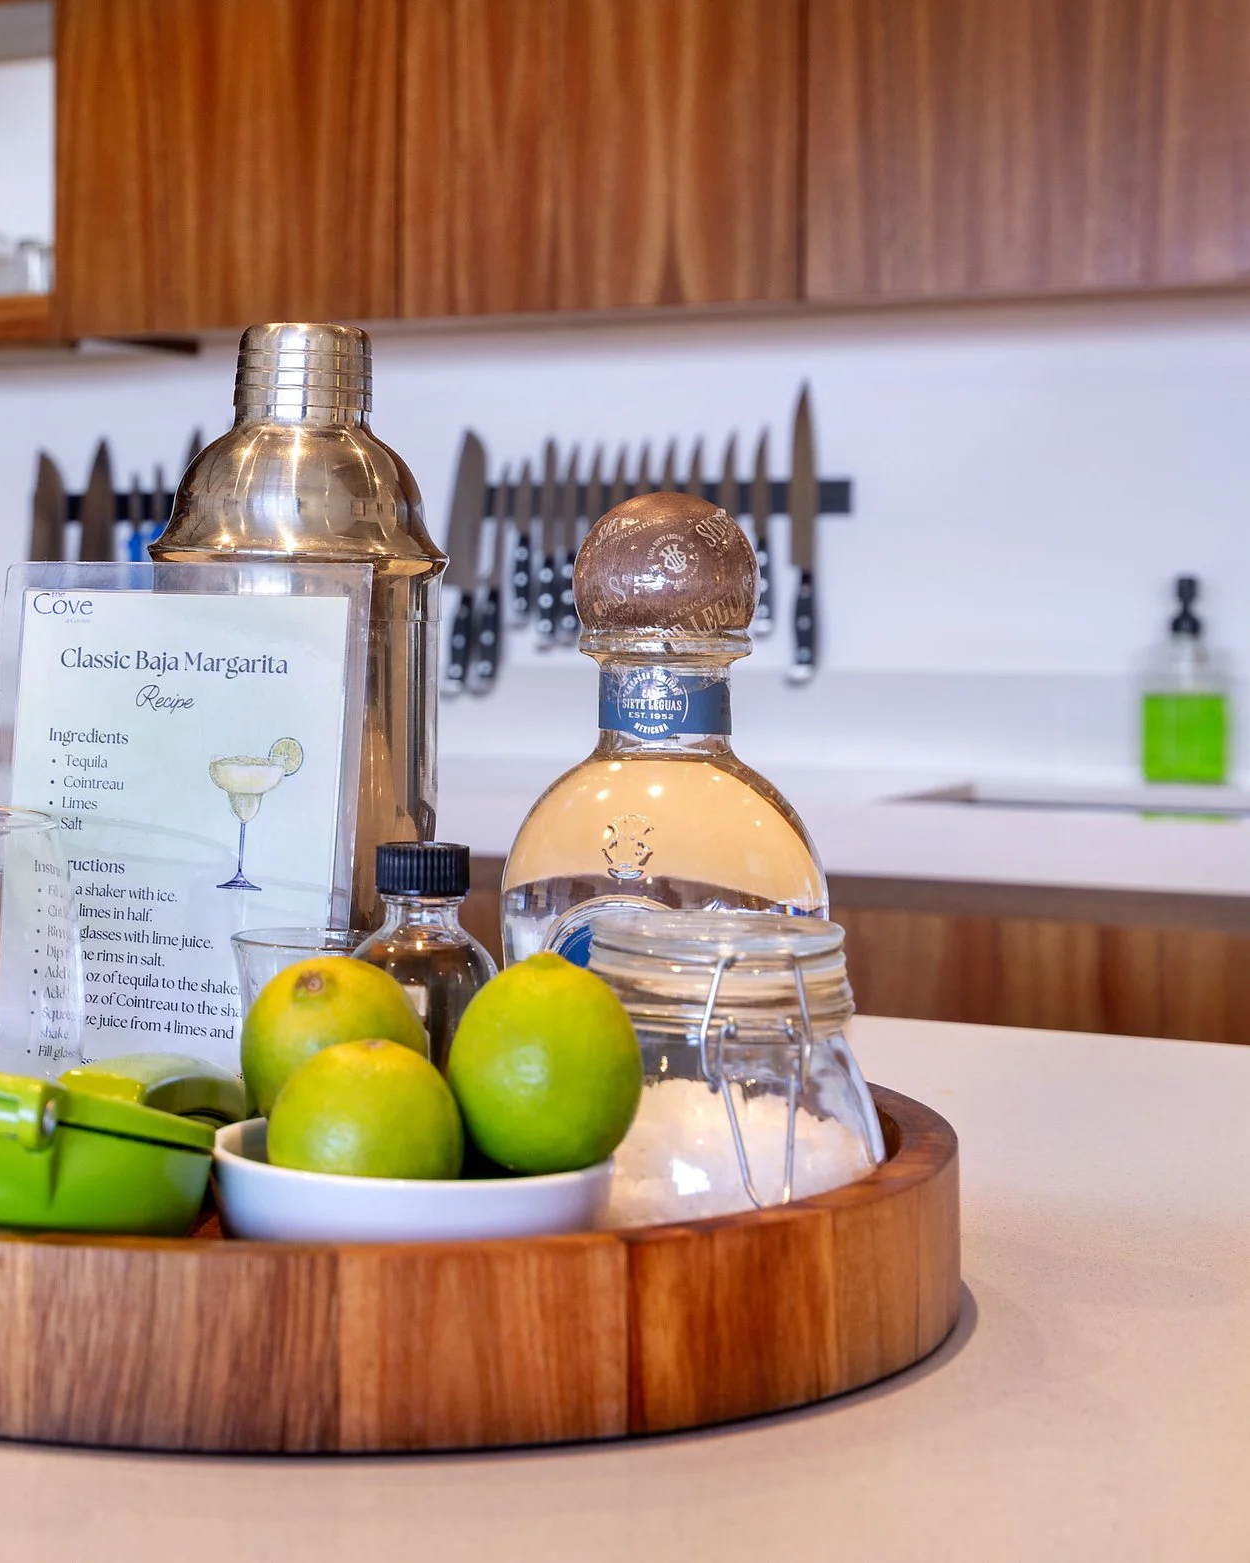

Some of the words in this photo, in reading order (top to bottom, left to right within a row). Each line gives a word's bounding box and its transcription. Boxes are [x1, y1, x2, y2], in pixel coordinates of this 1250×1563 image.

[33, 592, 93, 615] Cove
[60, 646, 130, 669] Classic
[135, 650, 179, 677] Baja
[184, 651, 288, 679] Margarita
[135, 684, 195, 714] Recipe
[622, 699, 645, 710] SIETE
[648, 699, 682, 711] LEGUAS
[628, 711, 648, 719] EST.
[650, 712, 675, 720] 1952
[49, 727, 129, 747] Ingredients
[633, 721, 670, 735] MEXICANA
[65, 754, 108, 771] Tequila
[63, 775, 124, 791] Cointreau
[61, 796, 98, 810] Limes
[60, 816, 82, 830] Salt
[75, 885, 82, 895] a
[85, 882, 126, 899] shaker
[129, 886, 154, 901] with
[157, 889, 178, 902] ice.
[79, 903, 111, 919] limes
[113, 907, 124, 920] in
[127, 906, 153, 922] half.
[80, 925, 122, 943] glasses
[124, 929, 149, 944] with
[152, 930, 179, 946] lime
[178, 934, 213, 951] juice.
[96, 949, 124, 964] rims
[127, 951, 138, 965] in
[140, 952, 165, 967] salt.
[85, 971, 101, 983] oz
[102, 970, 118, 984] of
[118, 973, 160, 991] tequila
[162, 977, 175, 990] to
[178, 976, 199, 992] the
[85, 993, 99, 1004] oz
[101, 991, 116, 1006] of
[116, 993, 178, 1013] Cointreau
[181, 1001, 195, 1014] to
[197, 1000, 218, 1016] the
[96, 1013, 128, 1030] juice
[130, 1015, 161, 1032] from
[164, 1020, 171, 1033] 4
[173, 1019, 207, 1037] limes
[209, 1025, 235, 1040] and
[38, 1044, 52, 1057] Fill
